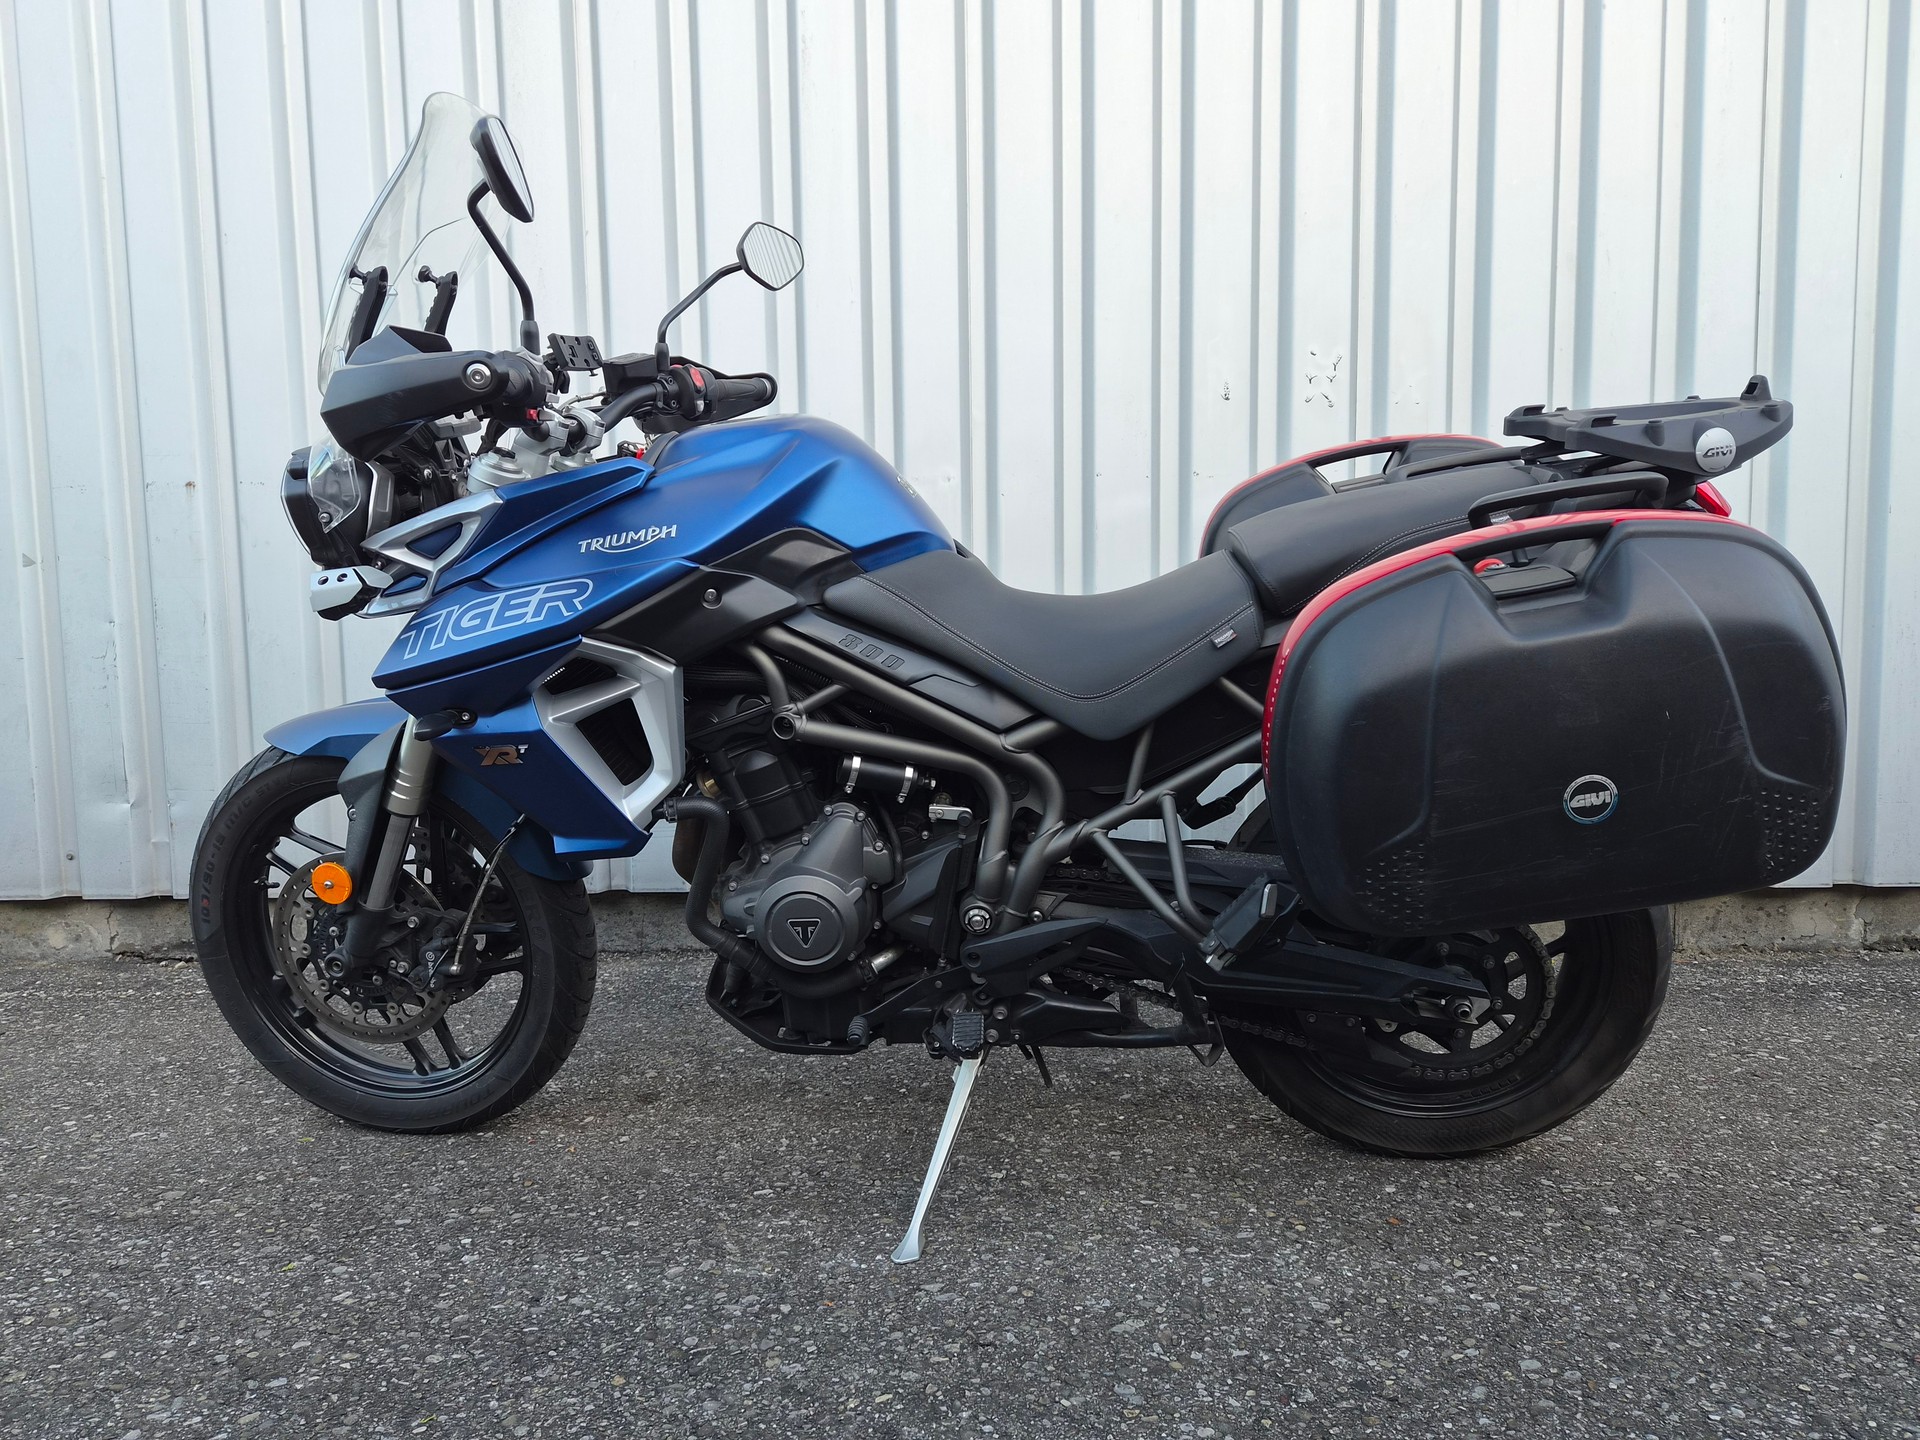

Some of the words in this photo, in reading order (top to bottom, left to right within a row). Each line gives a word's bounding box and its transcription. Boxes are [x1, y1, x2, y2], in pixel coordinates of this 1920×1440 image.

[1702, 444, 1733, 458] GIVI
[578, 524, 678, 553] TRIUMPH
[400, 578, 594, 660] TIGER
[838, 633, 906, 671] 800
[1569, 790, 1612, 808] GIVI
